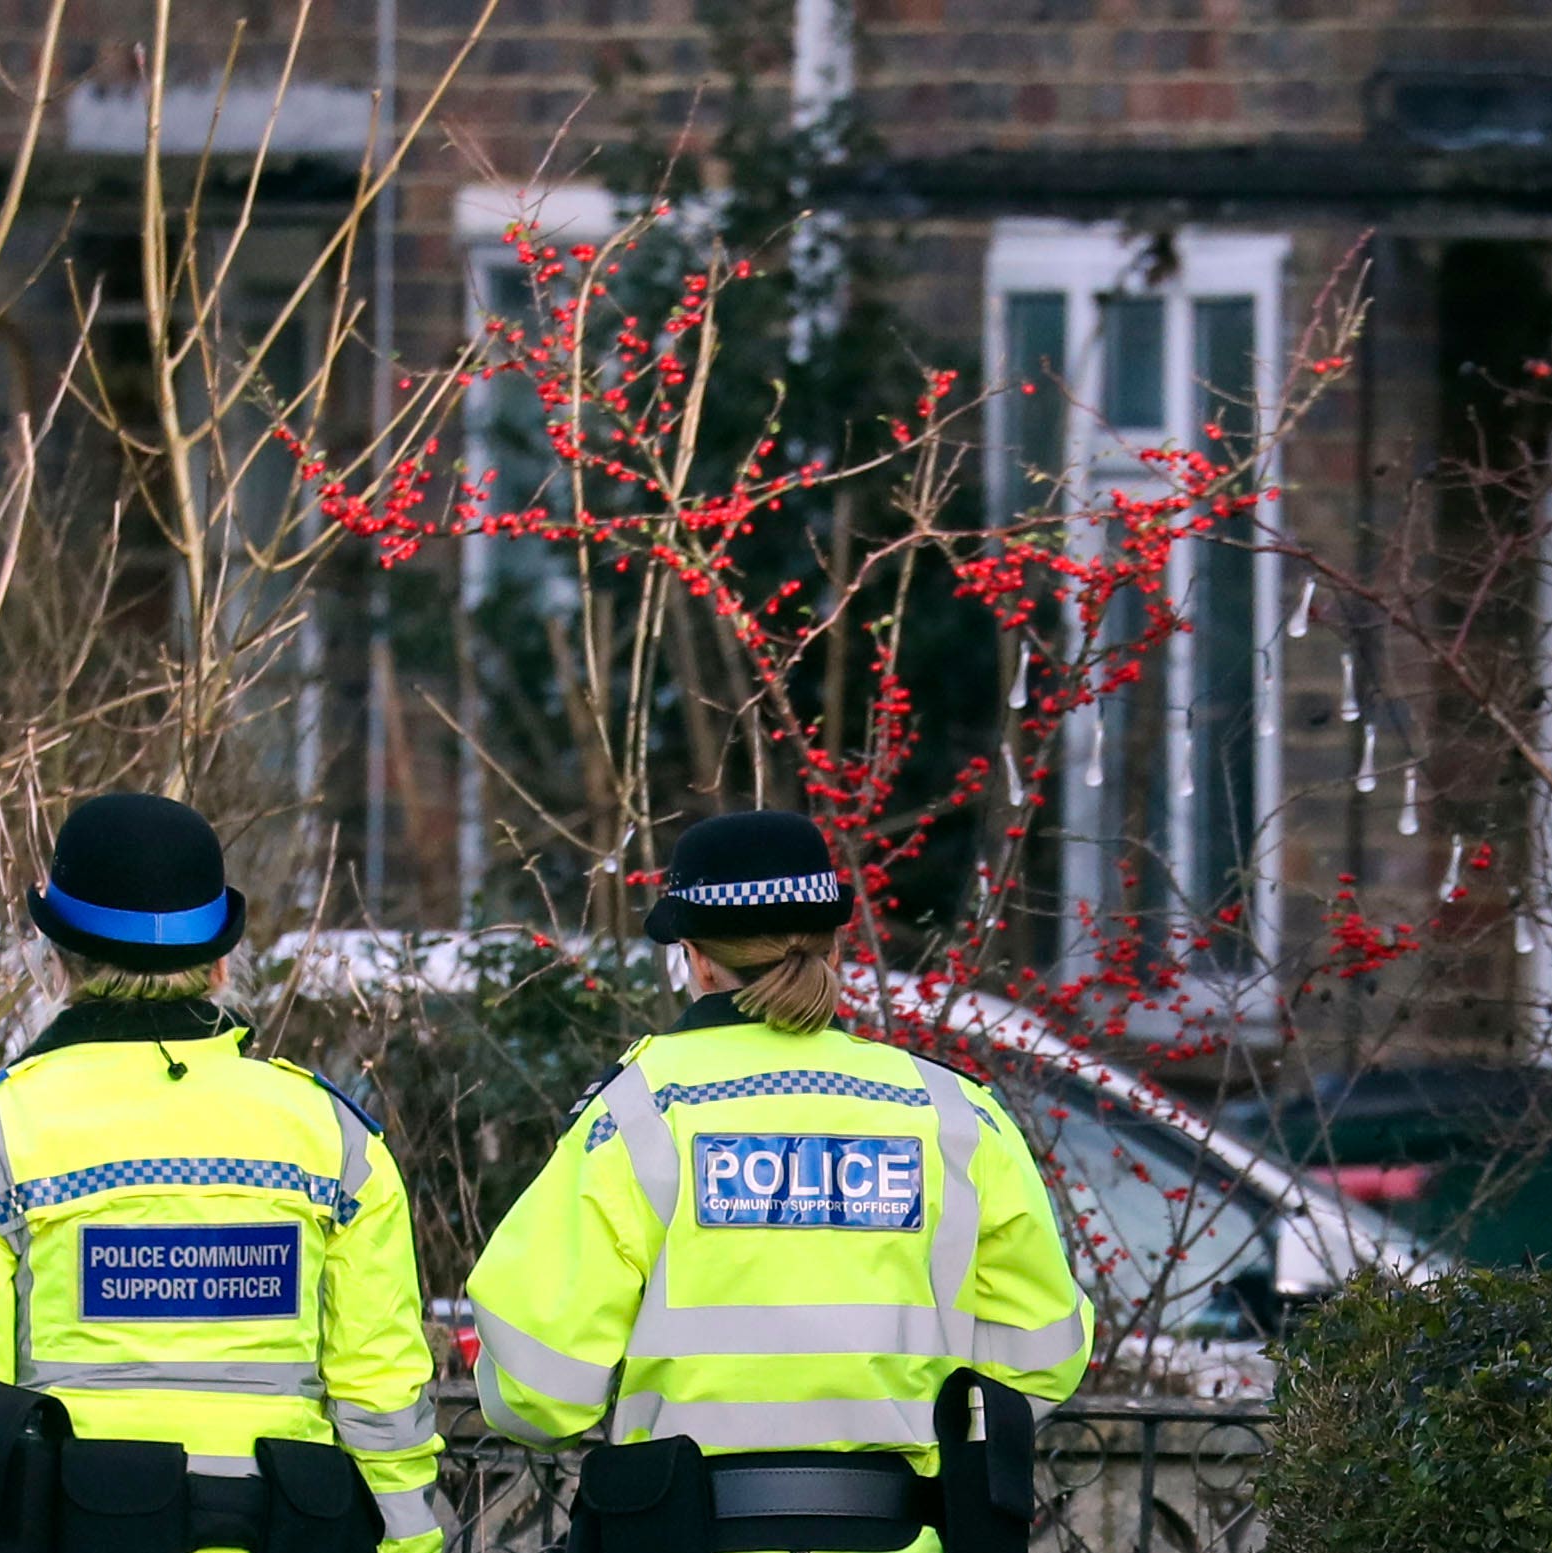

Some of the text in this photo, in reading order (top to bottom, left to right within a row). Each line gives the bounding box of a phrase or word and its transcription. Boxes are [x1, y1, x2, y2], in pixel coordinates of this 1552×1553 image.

[706, 1150, 912, 1198] POLICE
[709, 1198, 910, 1215] COMMUNITY SUPPORT OFFICER
[90, 1244, 291, 1268] POLICE COMMUNITY
[101, 1276, 282, 1300] SUPPORT OFFICER
